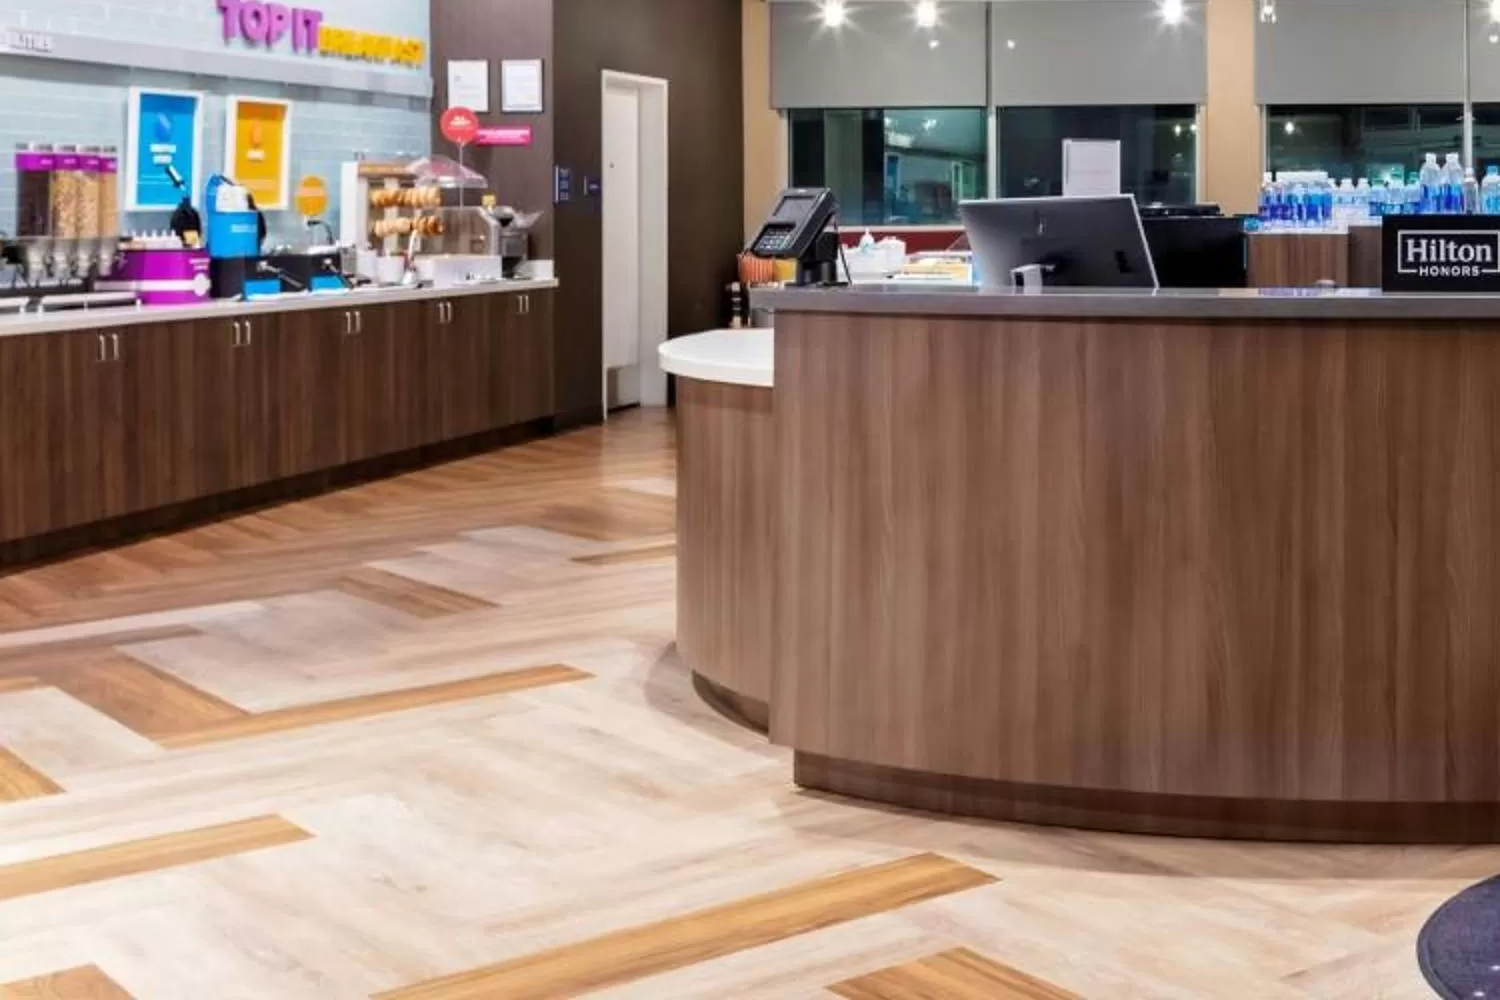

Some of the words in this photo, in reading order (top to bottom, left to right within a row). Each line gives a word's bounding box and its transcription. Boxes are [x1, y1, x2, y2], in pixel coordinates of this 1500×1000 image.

[291, 7, 323, 53] IT
[1406, 238, 1492, 263] Hilton
[1419, 265, 1481, 277] HONORS
